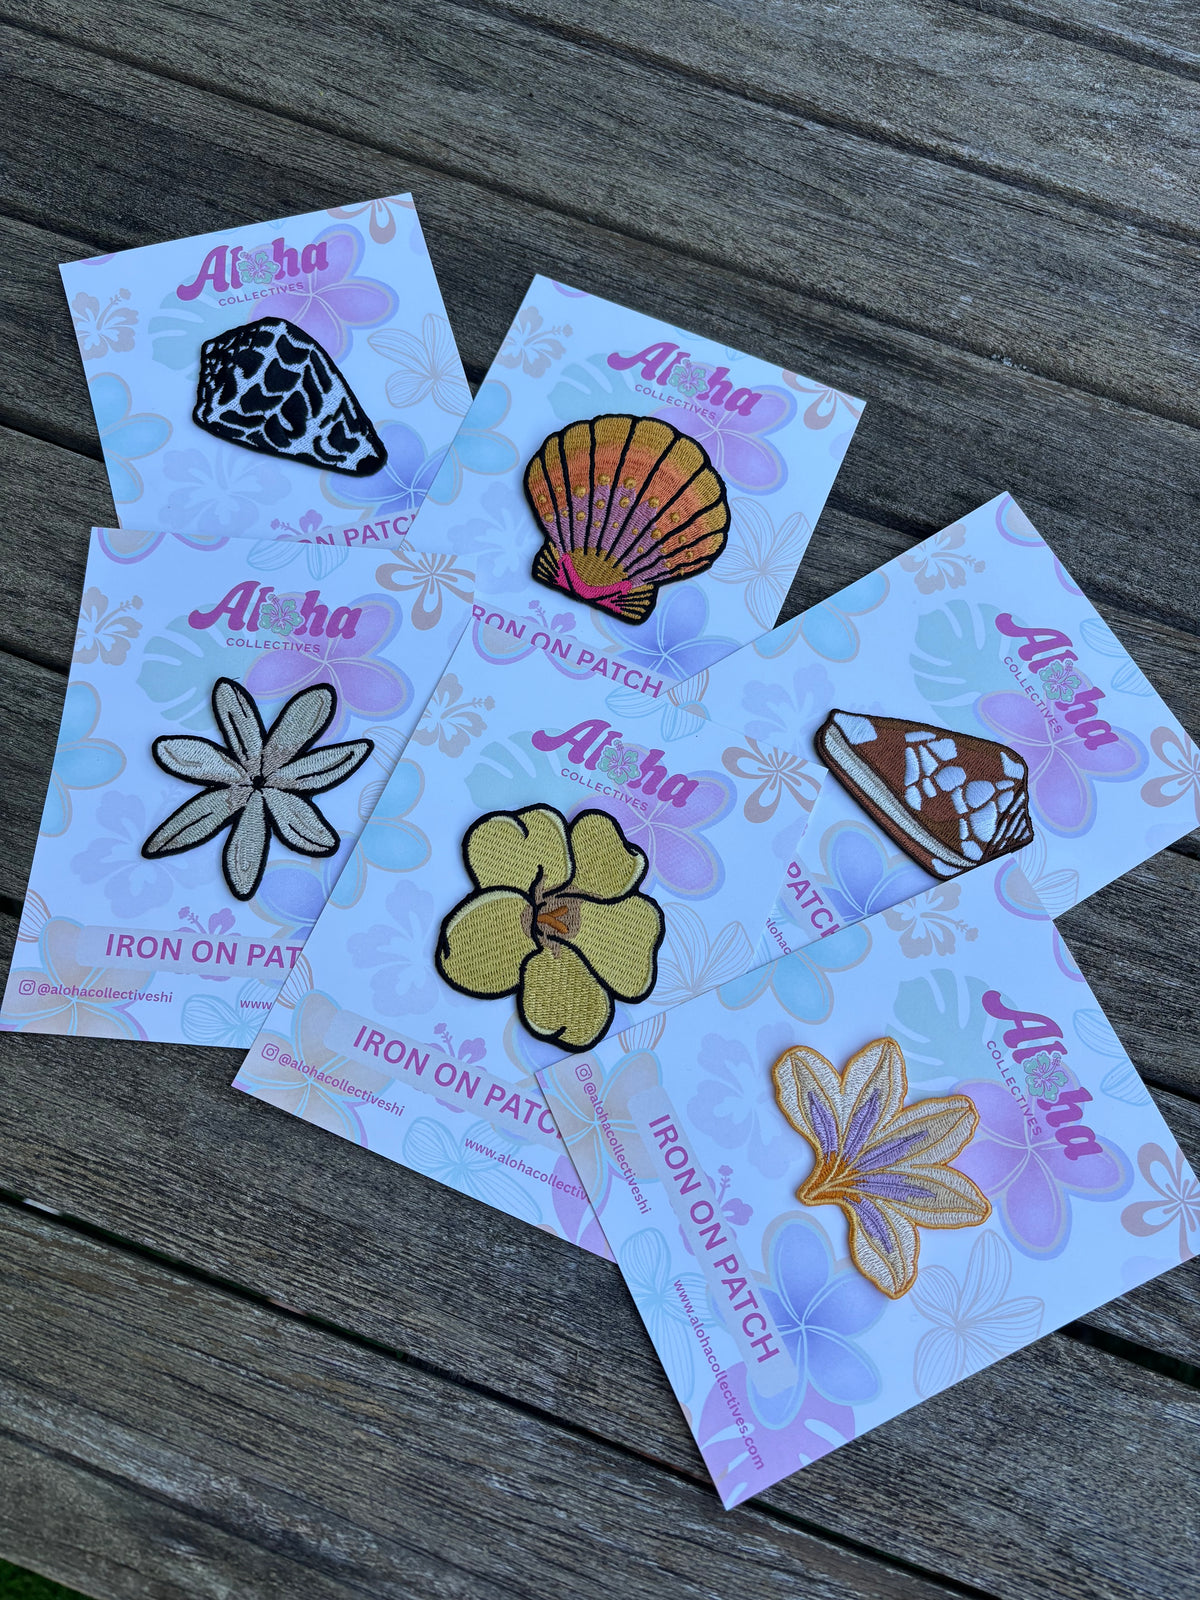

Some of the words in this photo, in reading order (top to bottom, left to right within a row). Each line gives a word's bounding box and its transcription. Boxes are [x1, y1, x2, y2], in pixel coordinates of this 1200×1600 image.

[218, 282, 304, 306] COLLECTIVES
[635, 384, 717, 420] COLLECTIVES
[343, 514, 416, 547] PATC
[226, 637, 321, 653] COLLECTIVES
[530, 632, 572, 660] ON
[576, 649, 664, 698] PATCH
[1003, 656, 1063, 734] COLLECTIVES
[561, 768, 649, 812] COLLECTIVES
[105, 933, 183, 961] IRON
[192, 940, 238, 965] ON
[247, 944, 304, 969] PAT
[37, 983, 173, 1003] @alohacollectiveshi
[278, 1053, 405, 1117] @alohacollectiveshi
[353, 1025, 430, 1076] IRON
[434, 1062, 482, 1099] ON
[483, 1083, 563, 1140] PATC
[986, 1040, 1042, 1136] COLLECTIVES
[464, 1138, 590, 1203] www.alohacollectiv
[583, 1082, 652, 1214] @alohacollectiveshi
[648, 1114, 702, 1196] IRON
[690, 1200, 728, 1251] ON
[713, 1253, 780, 1363] PATCH
[673, 1279, 765, 1470] www.alohacollectives.com
